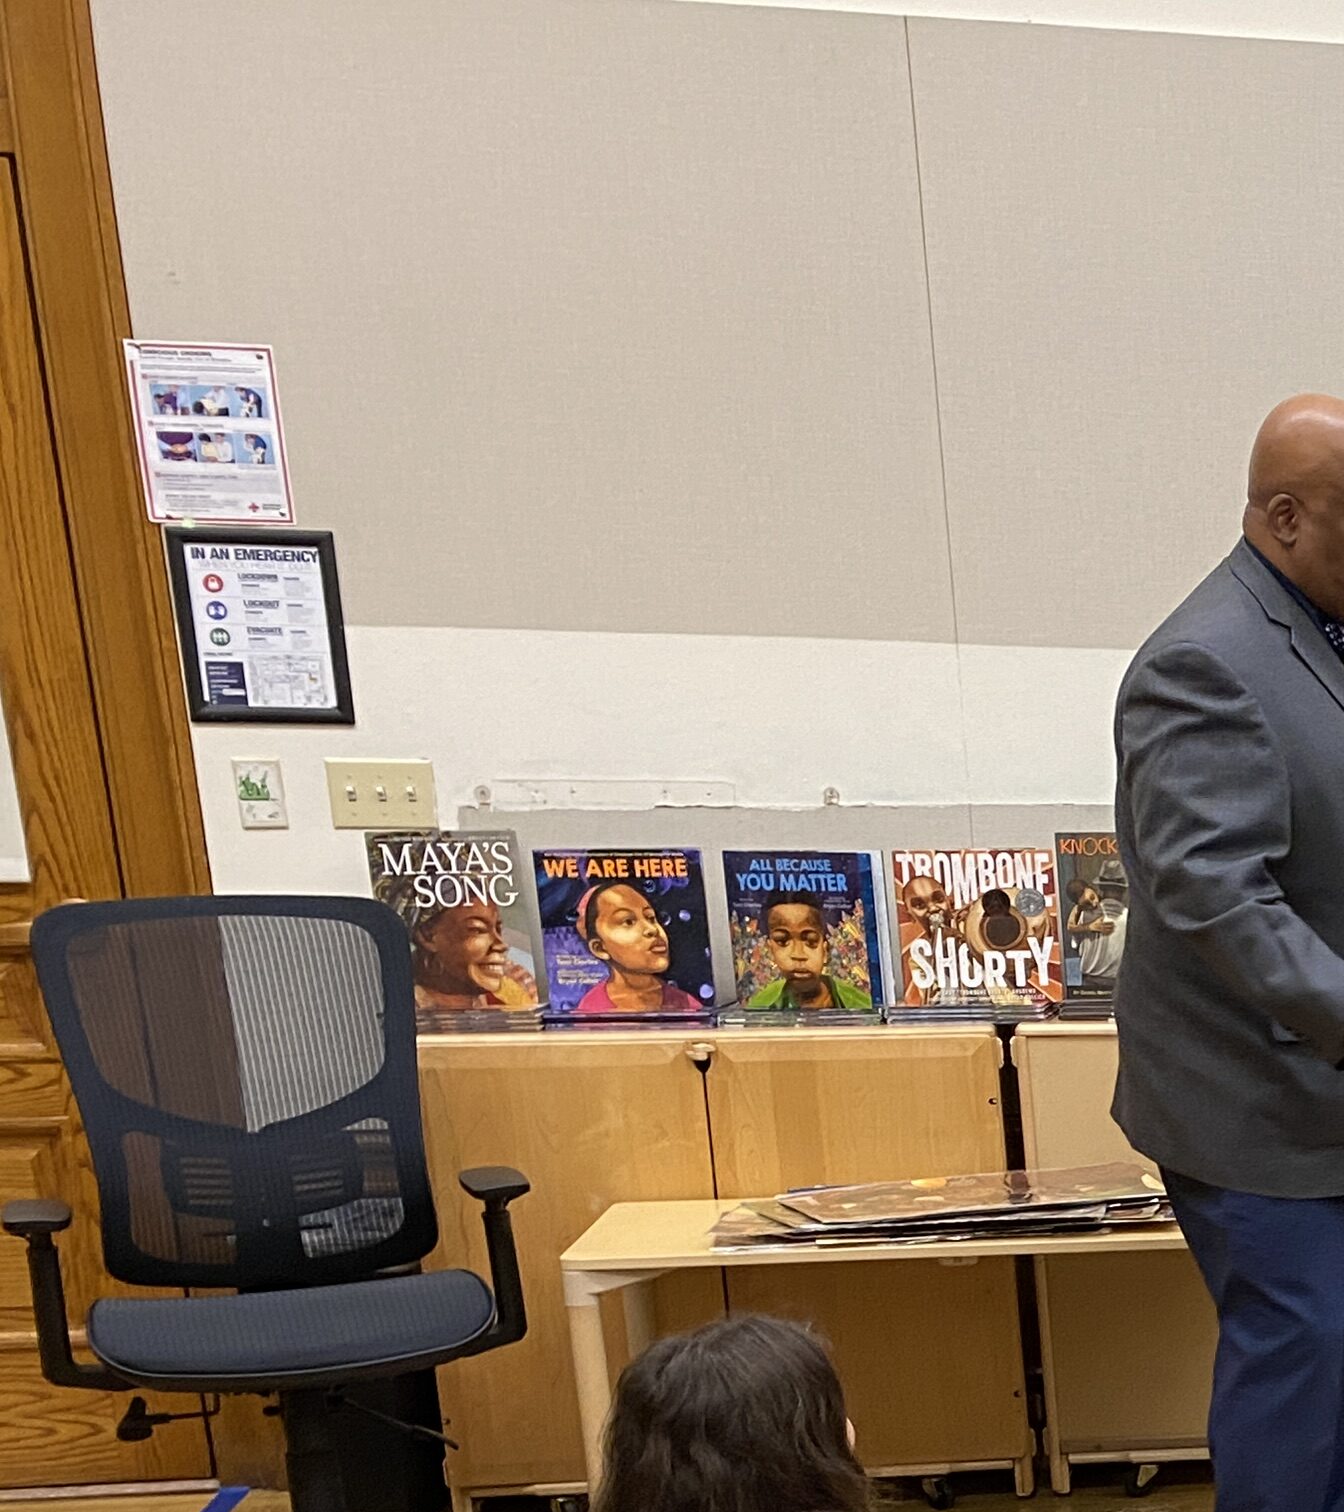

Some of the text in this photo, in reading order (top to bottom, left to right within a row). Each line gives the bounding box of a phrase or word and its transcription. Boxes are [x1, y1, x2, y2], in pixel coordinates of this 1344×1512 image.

[191, 547, 318, 563] IN AN EMERGENCY
[1059, 837, 1118, 856] KNOCK
[378, 841, 513, 876] MAYA'S
[543, 858, 688, 878] WE ARE HERE
[750, 858, 832, 871] ALL BECAUSE
[736, 873, 848, 892] YOU MATTER
[895, 851, 1054, 910] TROMBONE
[413, 874, 519, 908] SONG
[910, 928, 1054, 990] SHORTY
